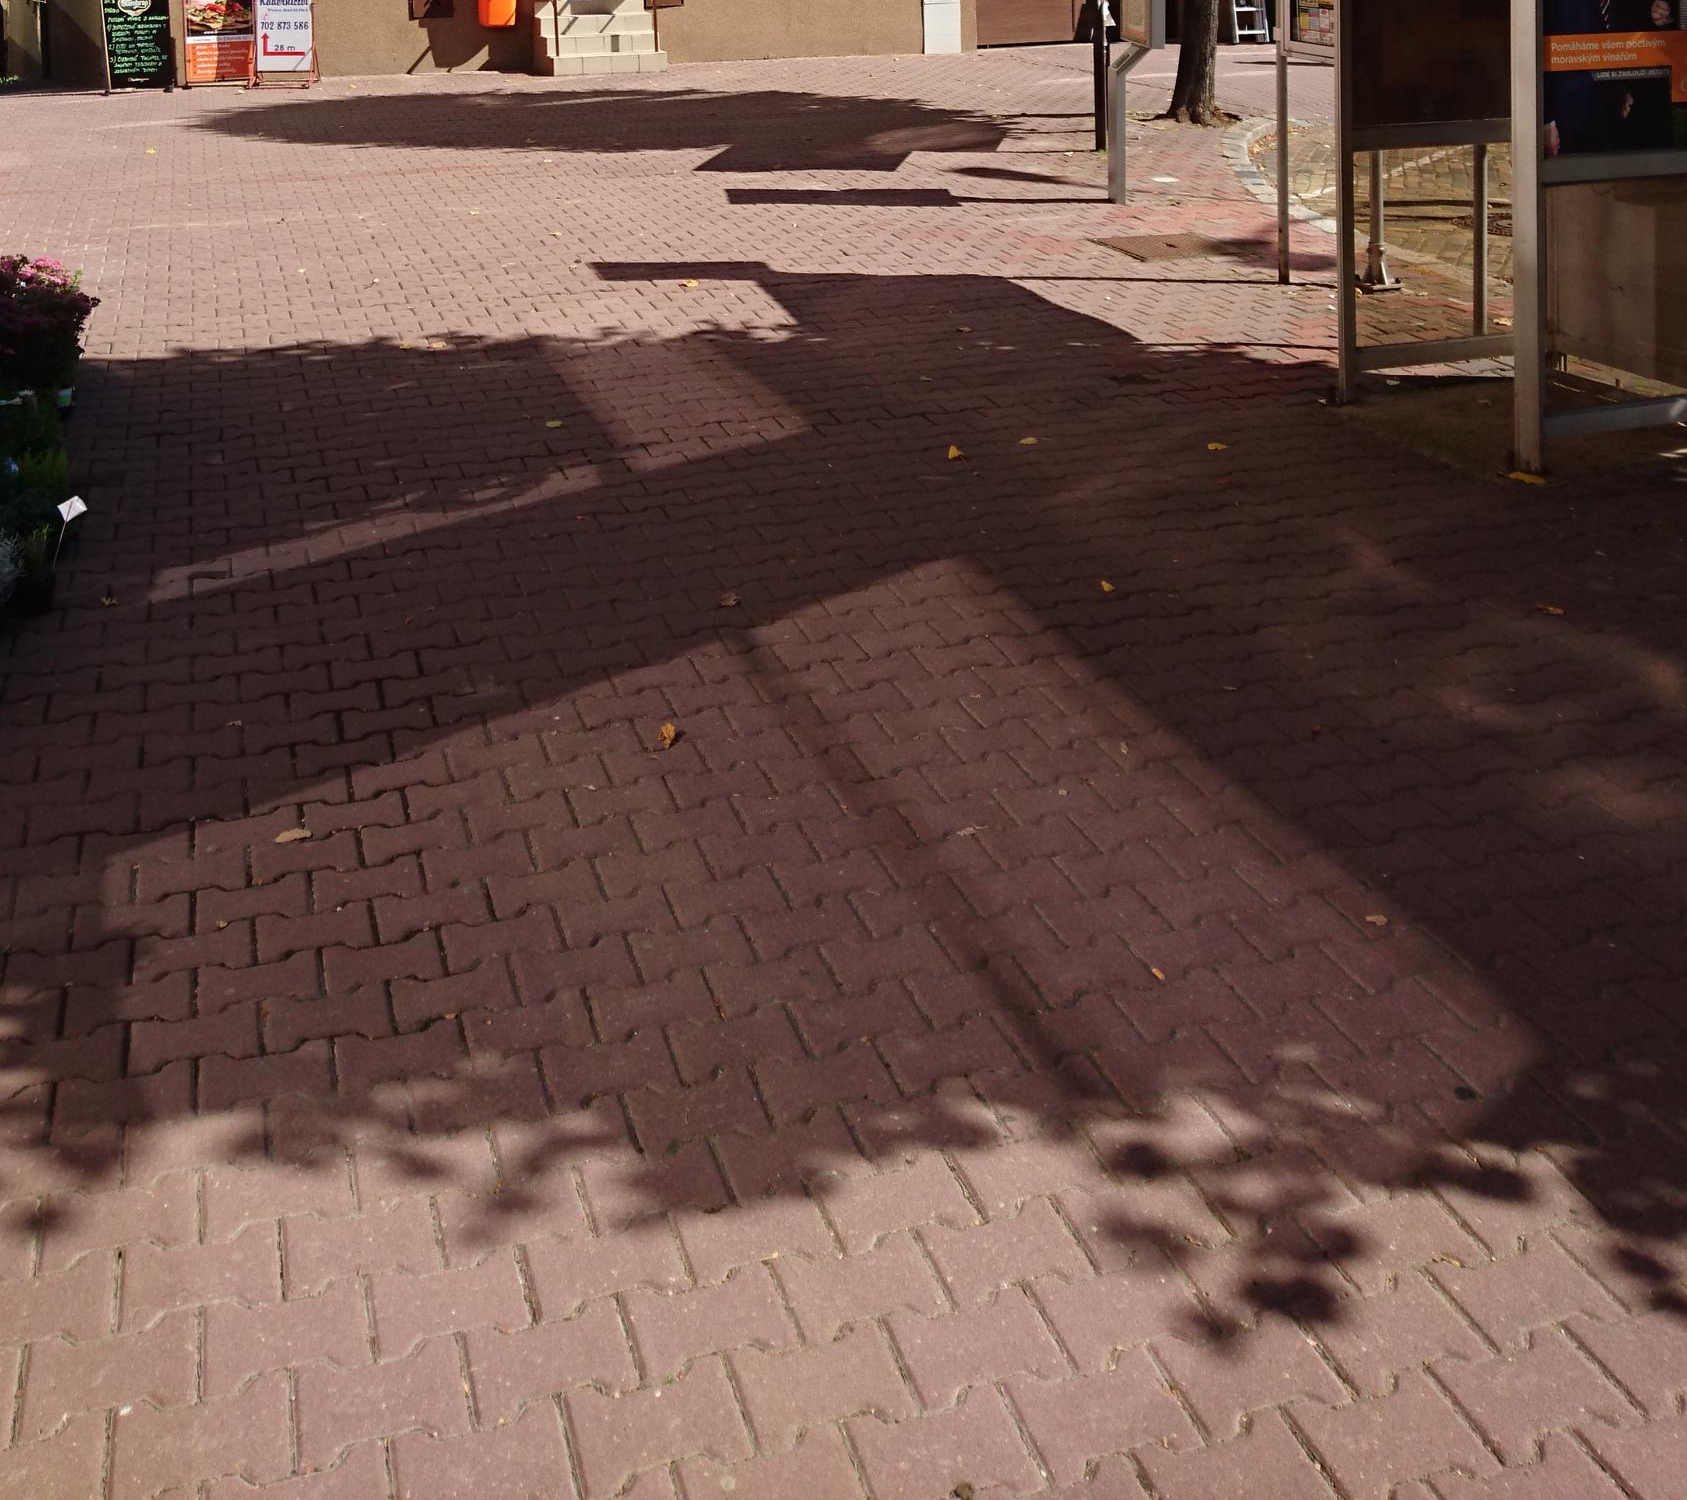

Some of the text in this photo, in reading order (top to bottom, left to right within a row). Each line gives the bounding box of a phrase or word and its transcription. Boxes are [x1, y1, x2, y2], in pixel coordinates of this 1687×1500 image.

[260, 21, 309, 30] 702 873 586
[274, 44, 284, 52] 28
[1551, 38, 1665, 52] Pomáháme všem poctivým
[1551, 52, 1637, 65] moravským vinařům
